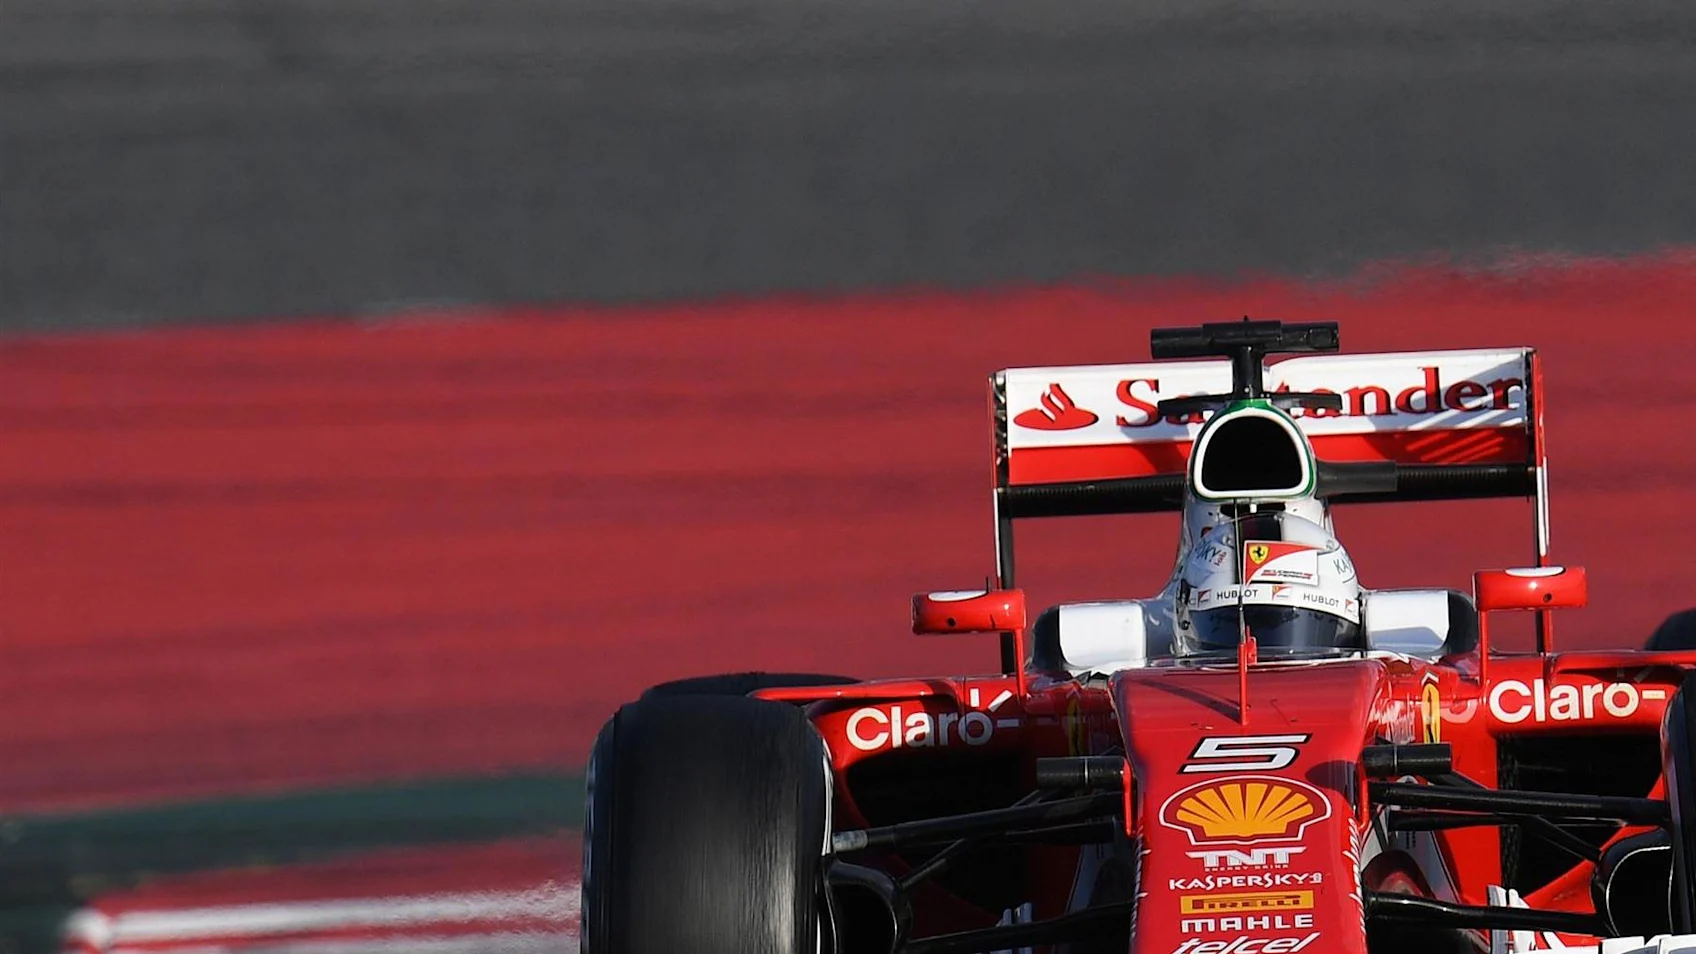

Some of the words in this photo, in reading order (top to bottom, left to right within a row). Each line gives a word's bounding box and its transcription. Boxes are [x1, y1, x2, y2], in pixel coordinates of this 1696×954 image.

[1116, 367, 1522, 427] Snder
[1303, 593, 1340, 608] HUBLOT
[1489, 679, 1640, 723] Claro
[846, 706, 994, 751] Claro
[1180, 733, 1311, 774] 5
[1185, 846, 1307, 867] TNT
[1169, 872, 1310, 891] KASPERSKY
[1181, 914, 1314, 933] MAHLE
